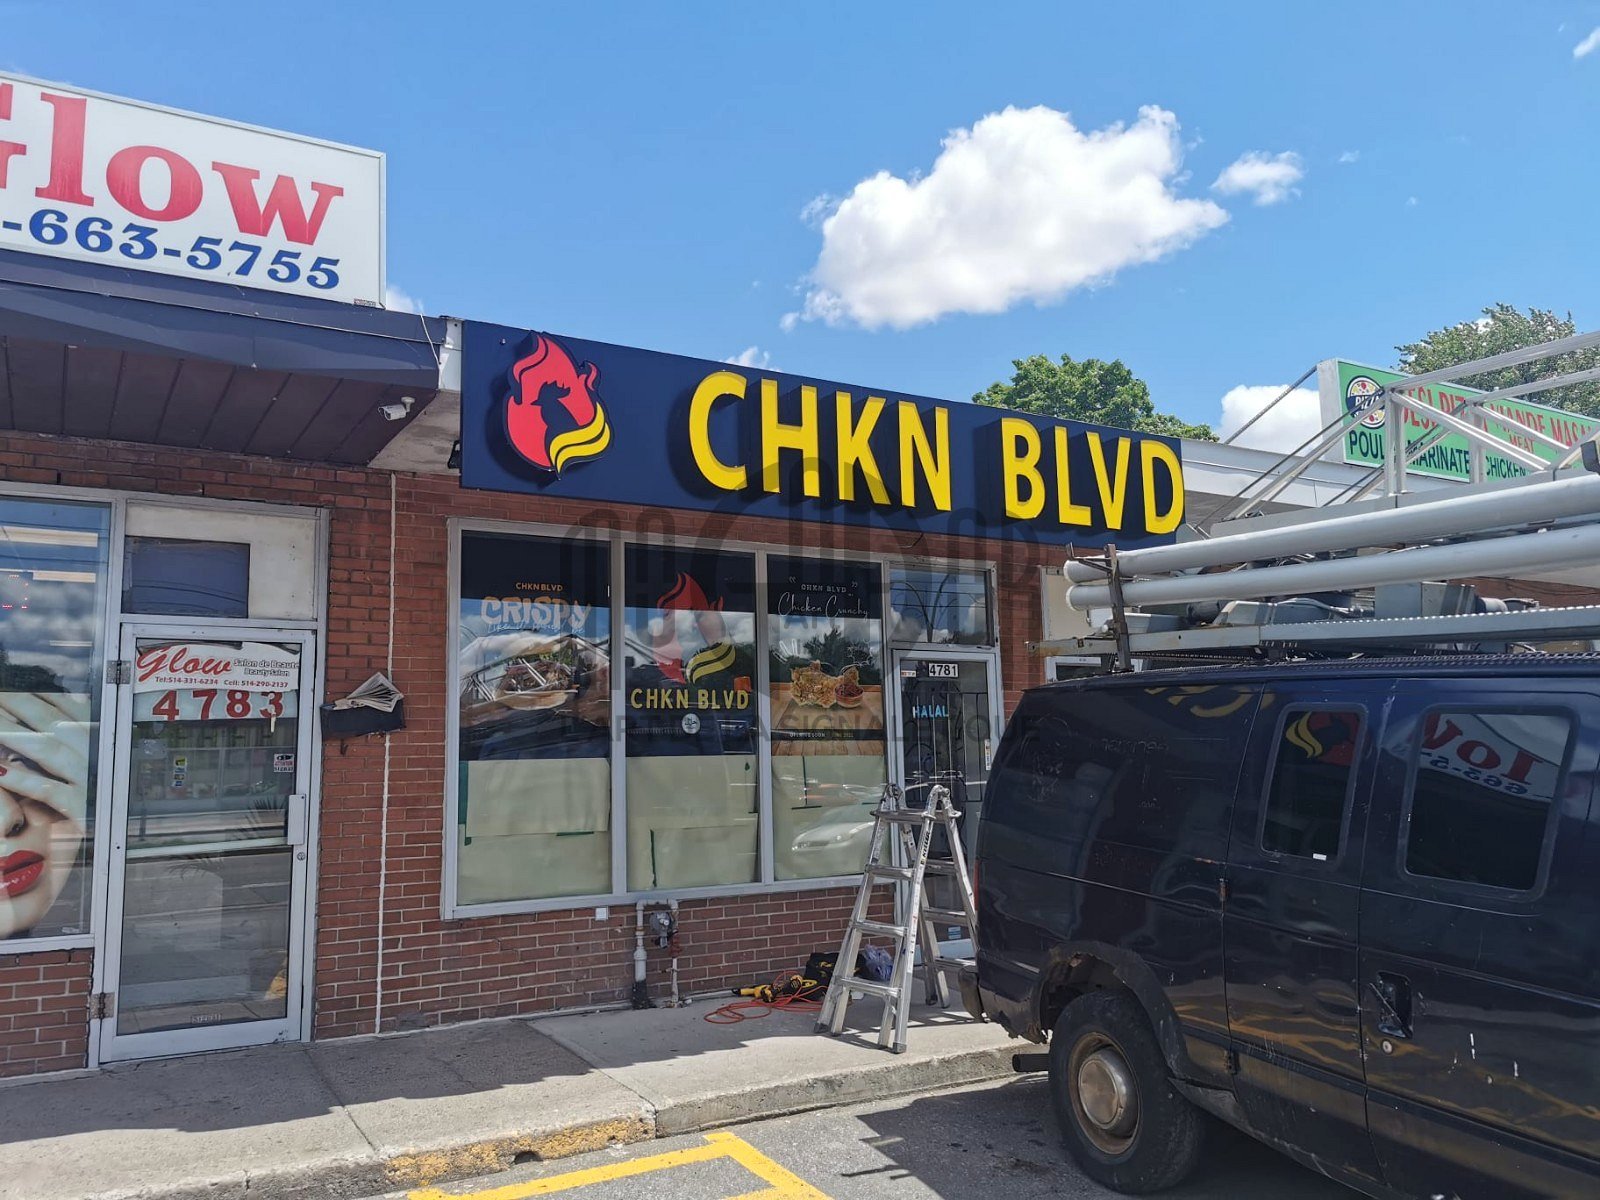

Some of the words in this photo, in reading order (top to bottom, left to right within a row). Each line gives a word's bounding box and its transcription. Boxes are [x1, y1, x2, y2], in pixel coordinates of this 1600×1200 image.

[688, 371, 952, 511] CHKN
[1001, 417, 1184, 534] BLVD
[1349, 430, 1386, 460] POUL
[516, 582, 540, 590] CHKN
[541, 583, 563, 592] BLVD
[481, 596, 592, 629] CRISPY
[778, 592, 822, 617] Chicken
[136, 646, 232, 682] Glow
[929, 664, 957, 676] 4781
[152, 689, 284, 721] 4783
[631, 688, 689, 709] CHKN
[697, 689, 749, 710] BLVD
[912, 705, 949, 718] HALAL
